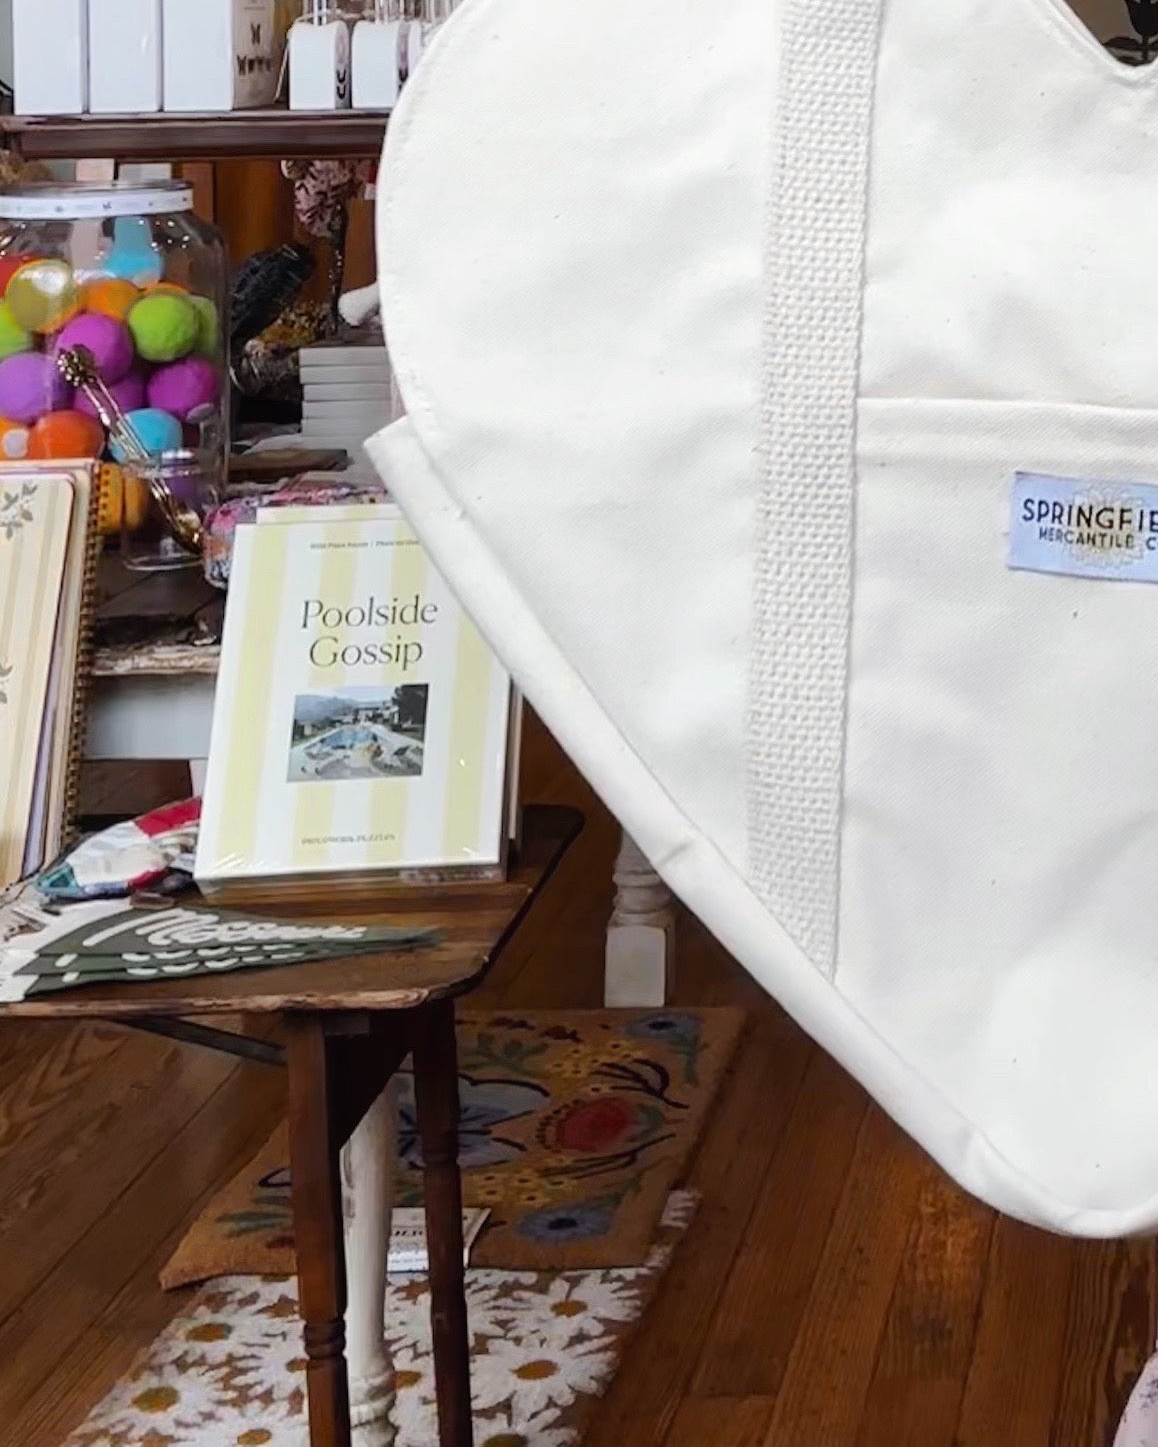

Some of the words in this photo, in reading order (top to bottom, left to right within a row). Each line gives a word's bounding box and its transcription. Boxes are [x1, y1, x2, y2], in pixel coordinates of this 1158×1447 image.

[1039, 526, 1134, 549] MERCANTILE
[301, 594, 438, 629] Poolside
[309, 634, 423, 671] Gossip
